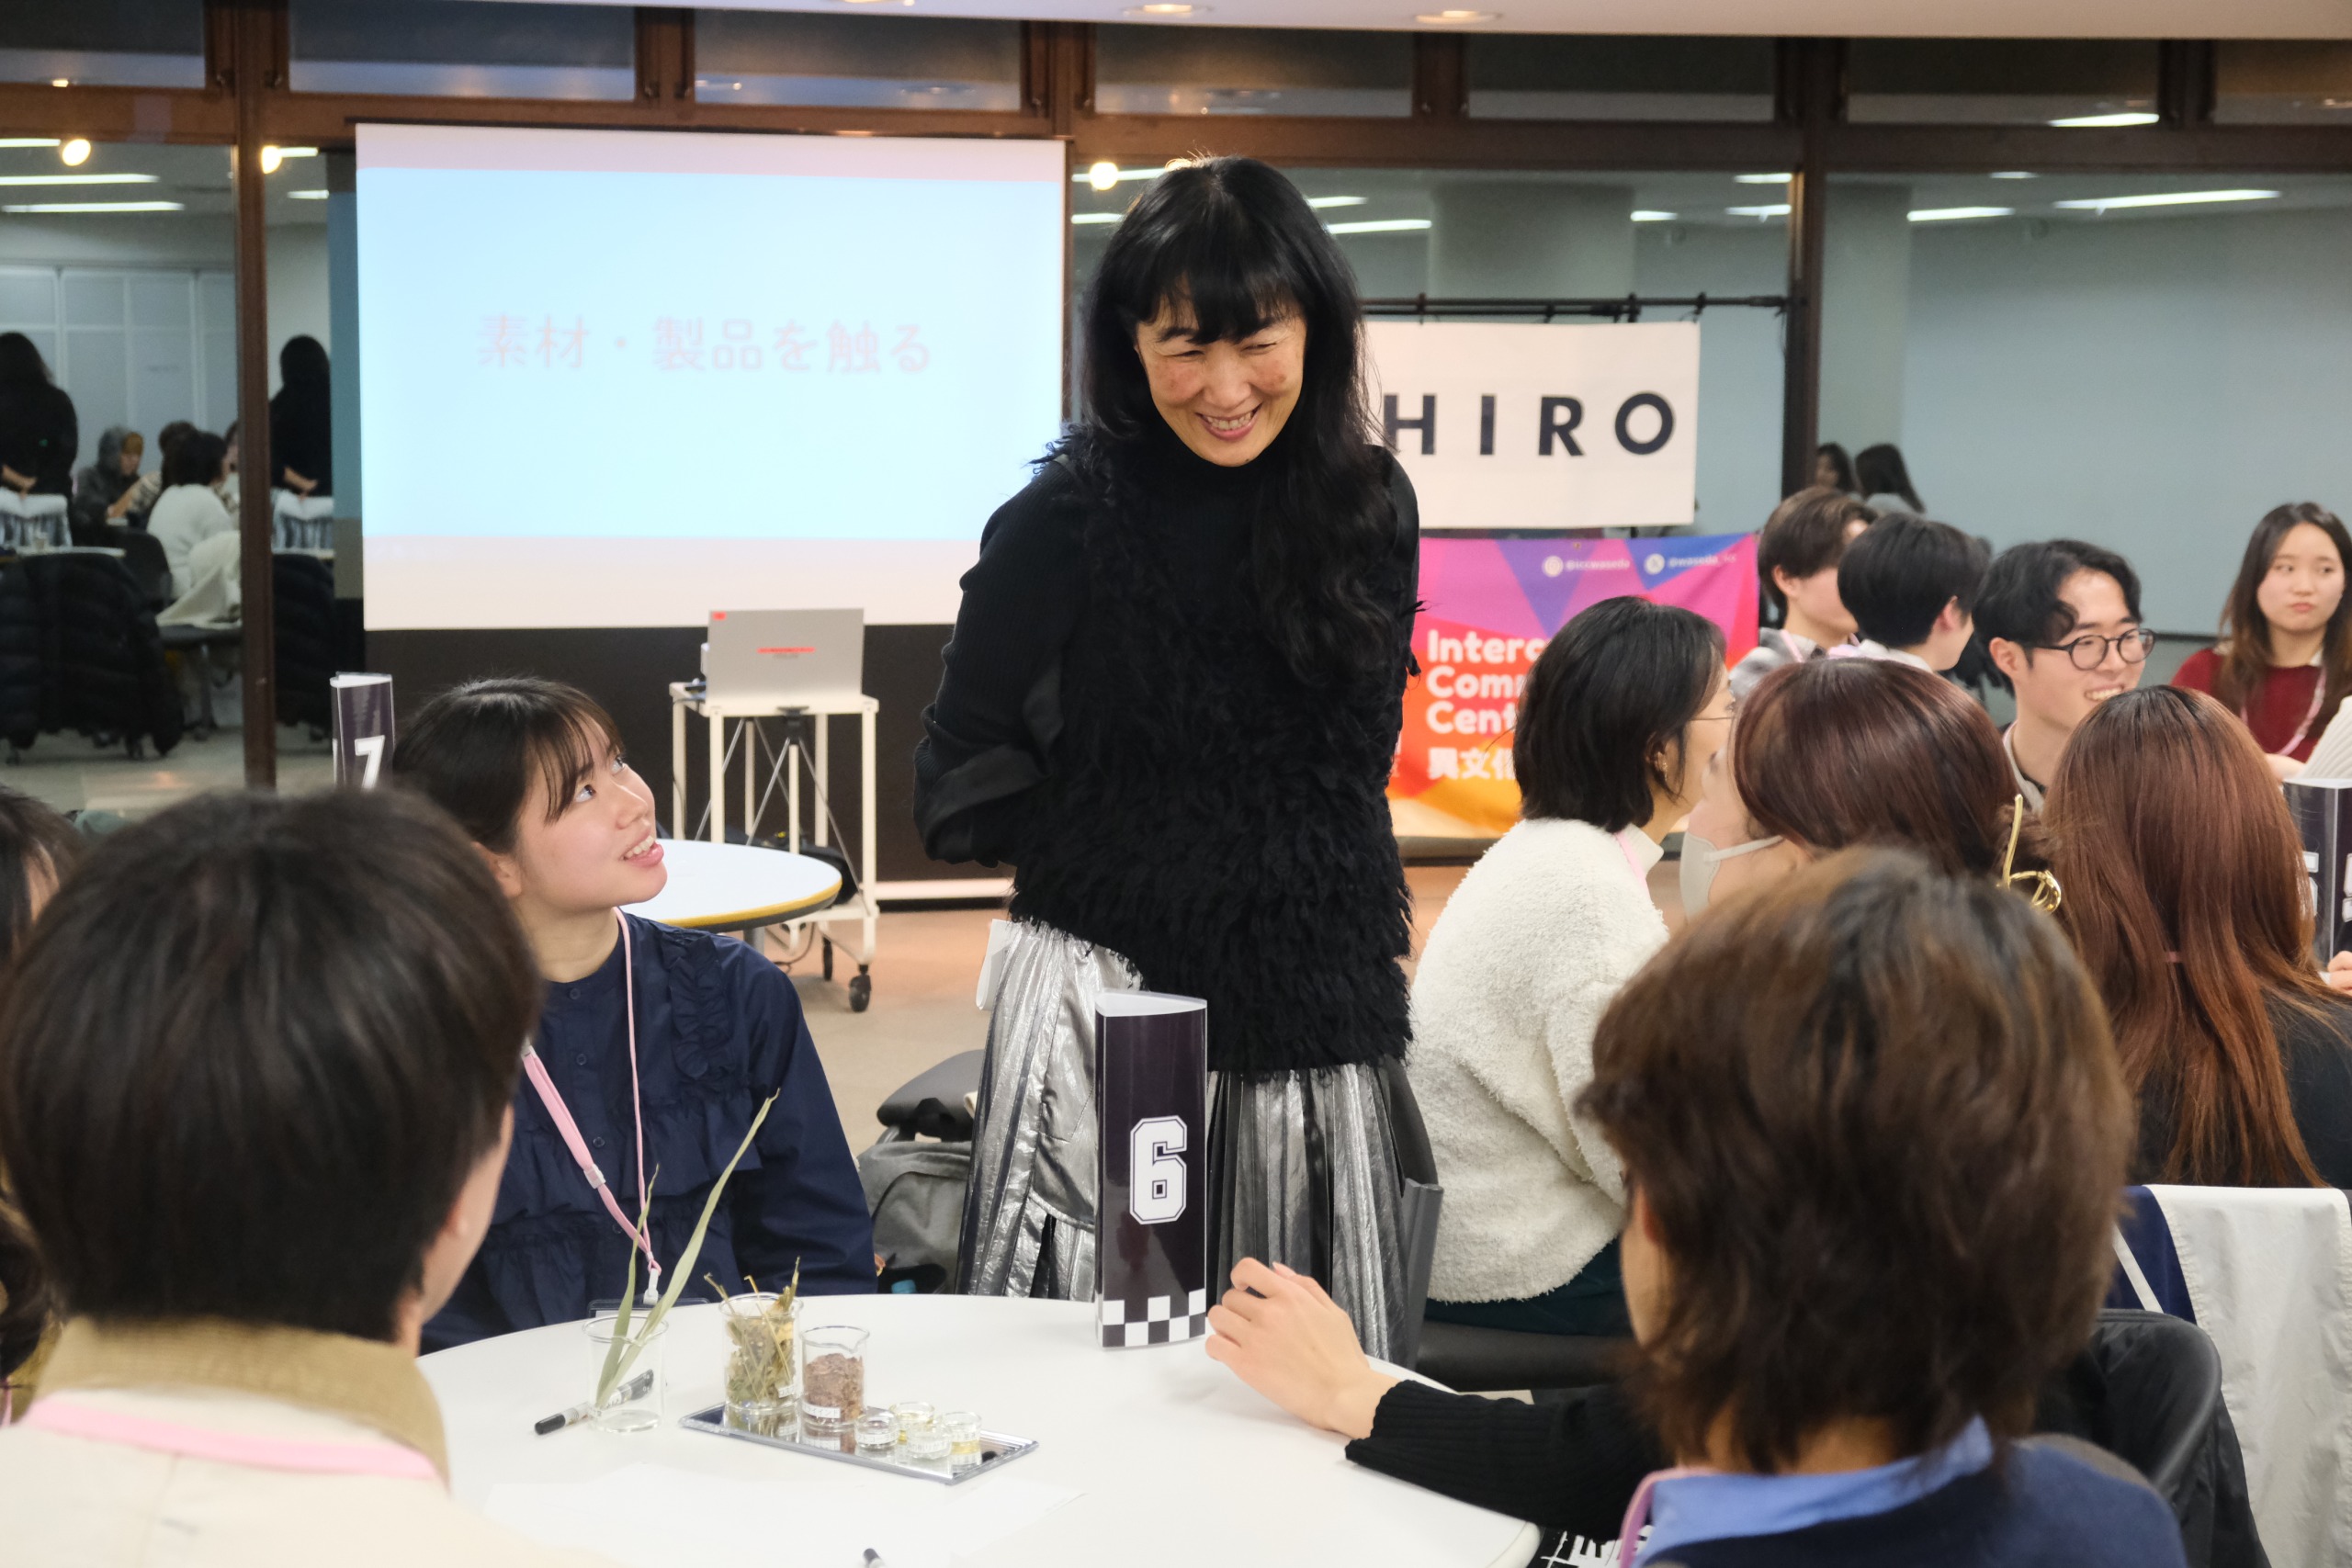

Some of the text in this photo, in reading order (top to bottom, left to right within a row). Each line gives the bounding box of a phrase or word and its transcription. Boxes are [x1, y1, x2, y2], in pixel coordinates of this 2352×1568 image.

[477, 314, 931, 373] 素材・製品を触る
[1383, 391, 1675, 457] HIRO
[354, 735, 386, 792] 7
[1129, 1114, 1188, 1225] 6
